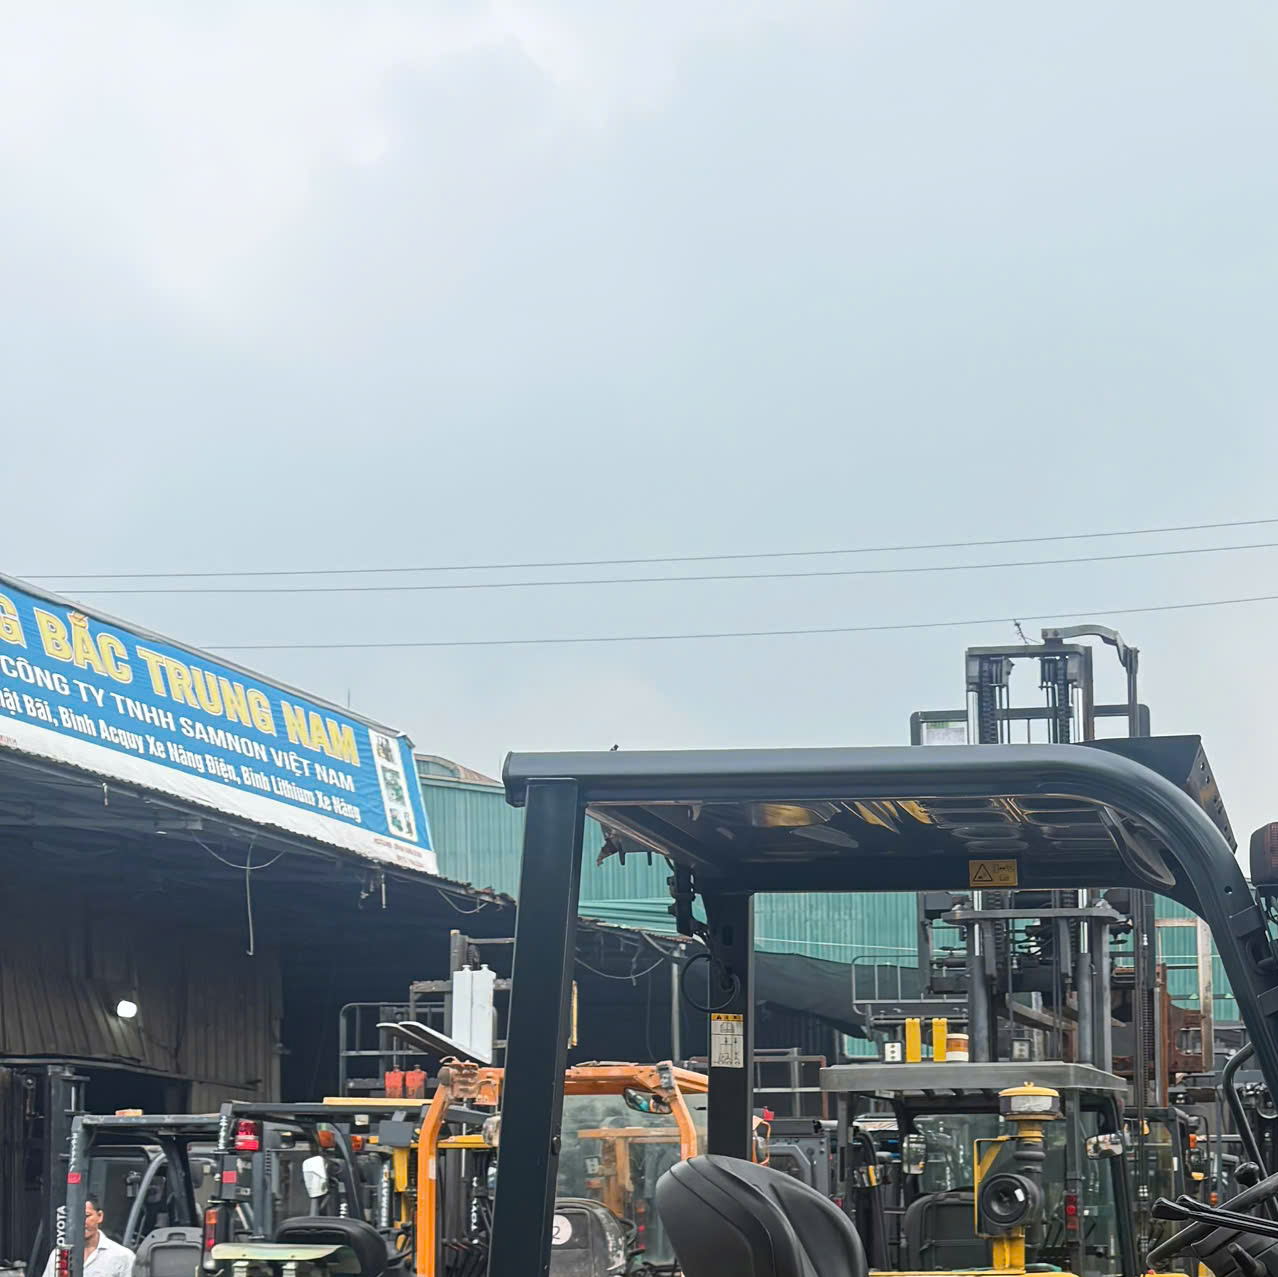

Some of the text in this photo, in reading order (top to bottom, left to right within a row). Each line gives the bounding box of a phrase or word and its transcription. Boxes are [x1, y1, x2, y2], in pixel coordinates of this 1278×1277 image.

[0, 655, 355, 792] CÔNG TY TNHH SAMNON VIỆT NAM
[136, 645, 277, 737] TRUNG
[281, 700, 360, 767] NAM
[99, 718, 144, 754] Acquy
[145, 734, 167, 759] Xe
[270, 775, 316, 806] Lithium
[314, 790, 332, 811] Xe
[56, 1205, 67, 1246] OYOTA
